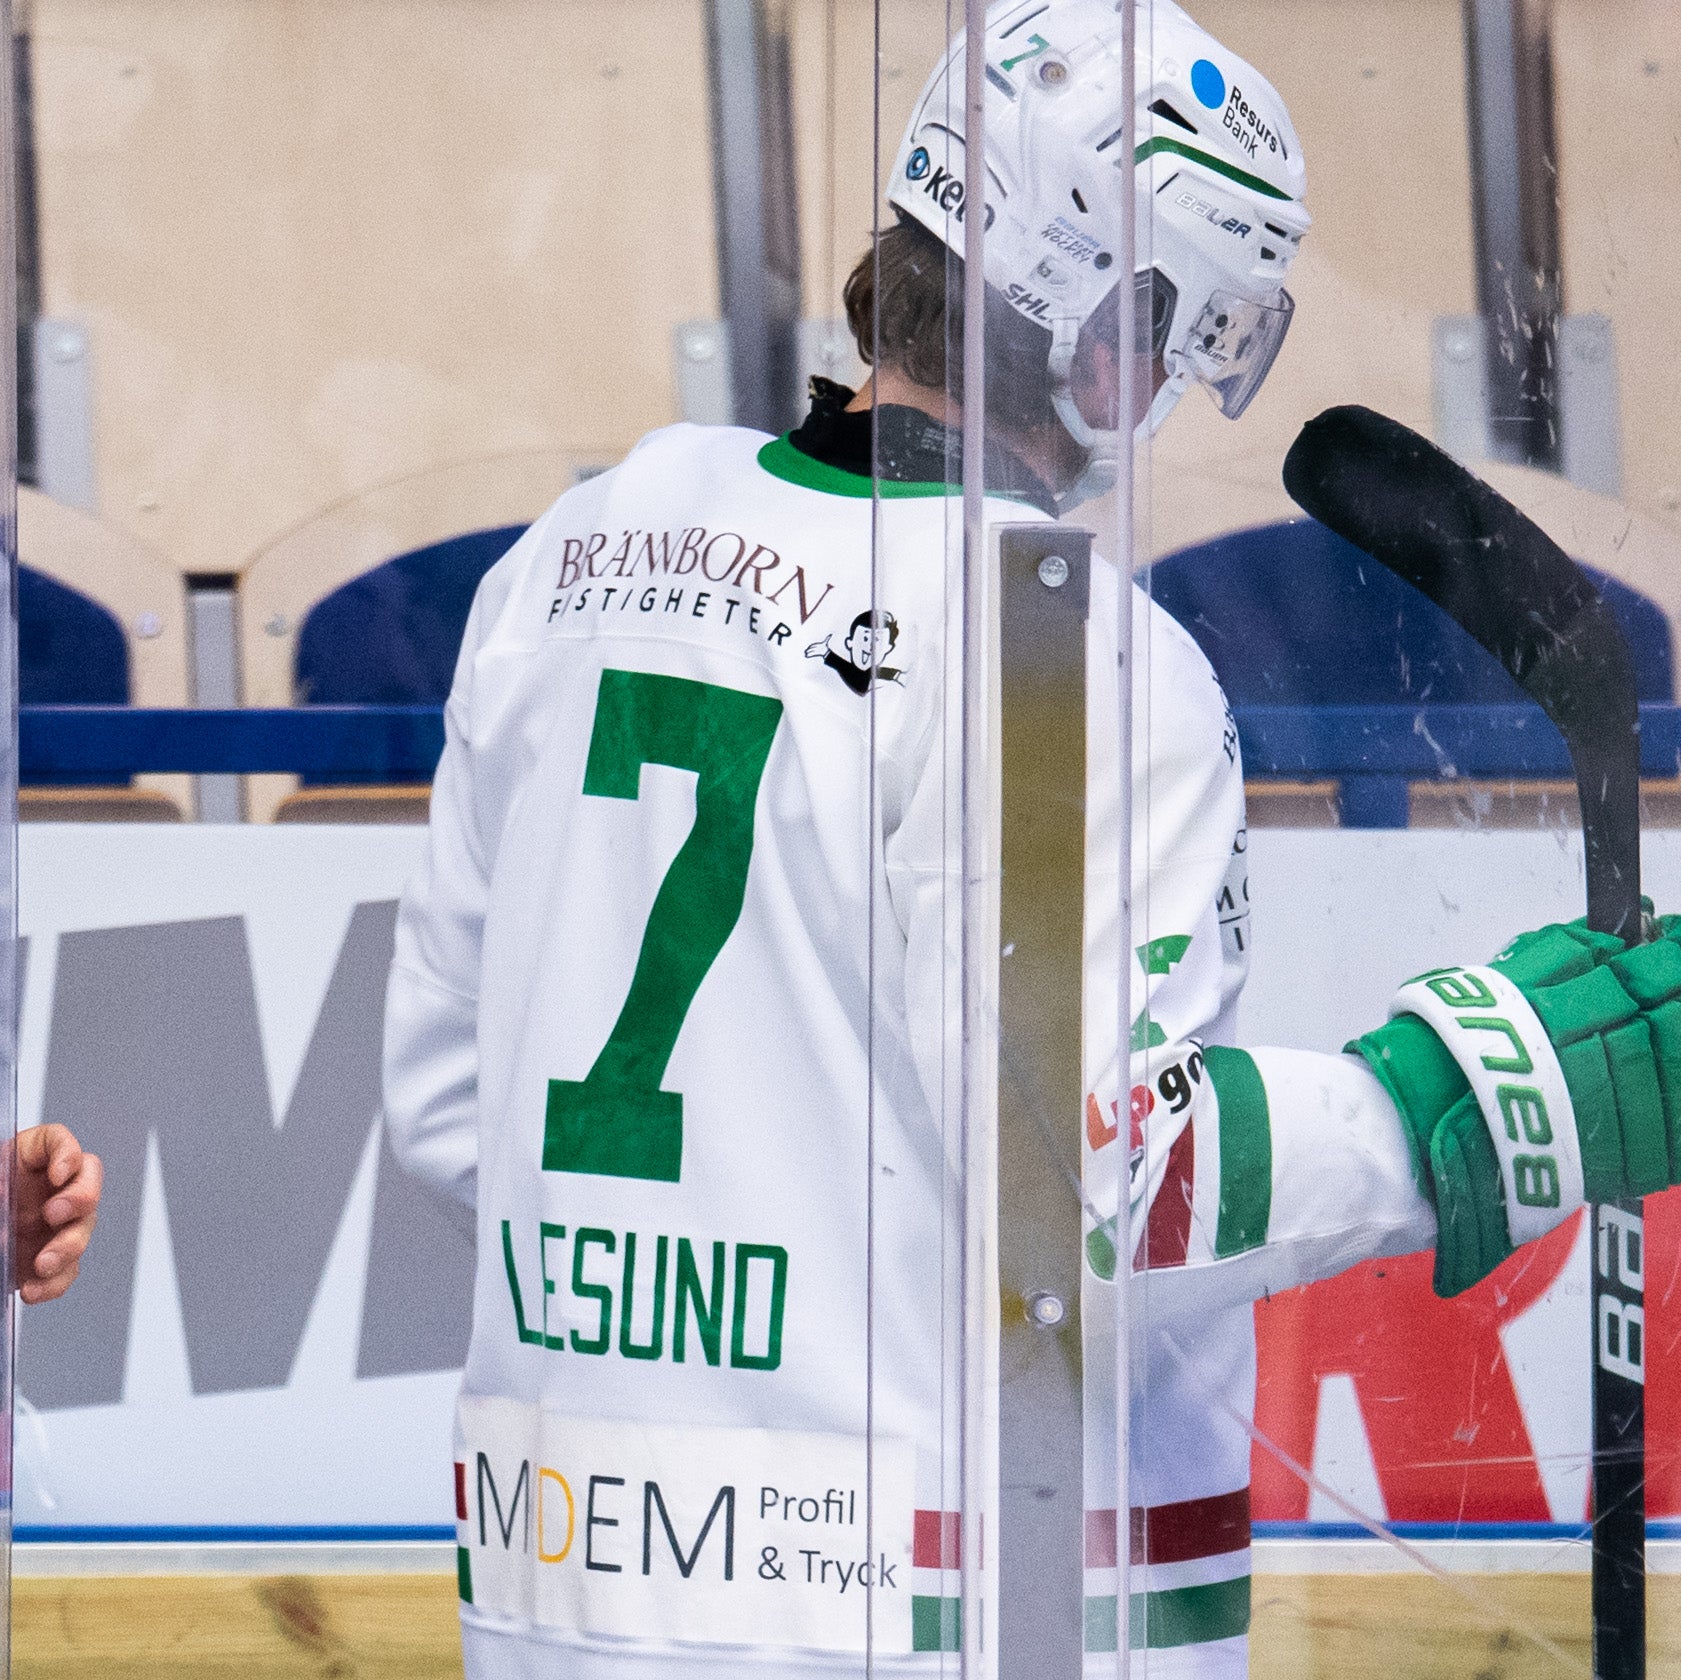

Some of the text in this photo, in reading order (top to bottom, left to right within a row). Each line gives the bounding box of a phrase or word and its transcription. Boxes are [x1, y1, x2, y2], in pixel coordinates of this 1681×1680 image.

[1000, 33, 1050, 72] 7
[1223, 106, 1258, 159] Bank
[1230, 86, 1277, 153] Resurs
[1001, 283, 1052, 320] SHL
[542, 668, 784, 1183] 7
[502, 1219, 788, 1372] LESUND
[758, 1487, 856, 1525] Profil
[757, 1549, 898, 1593] & Tryck
